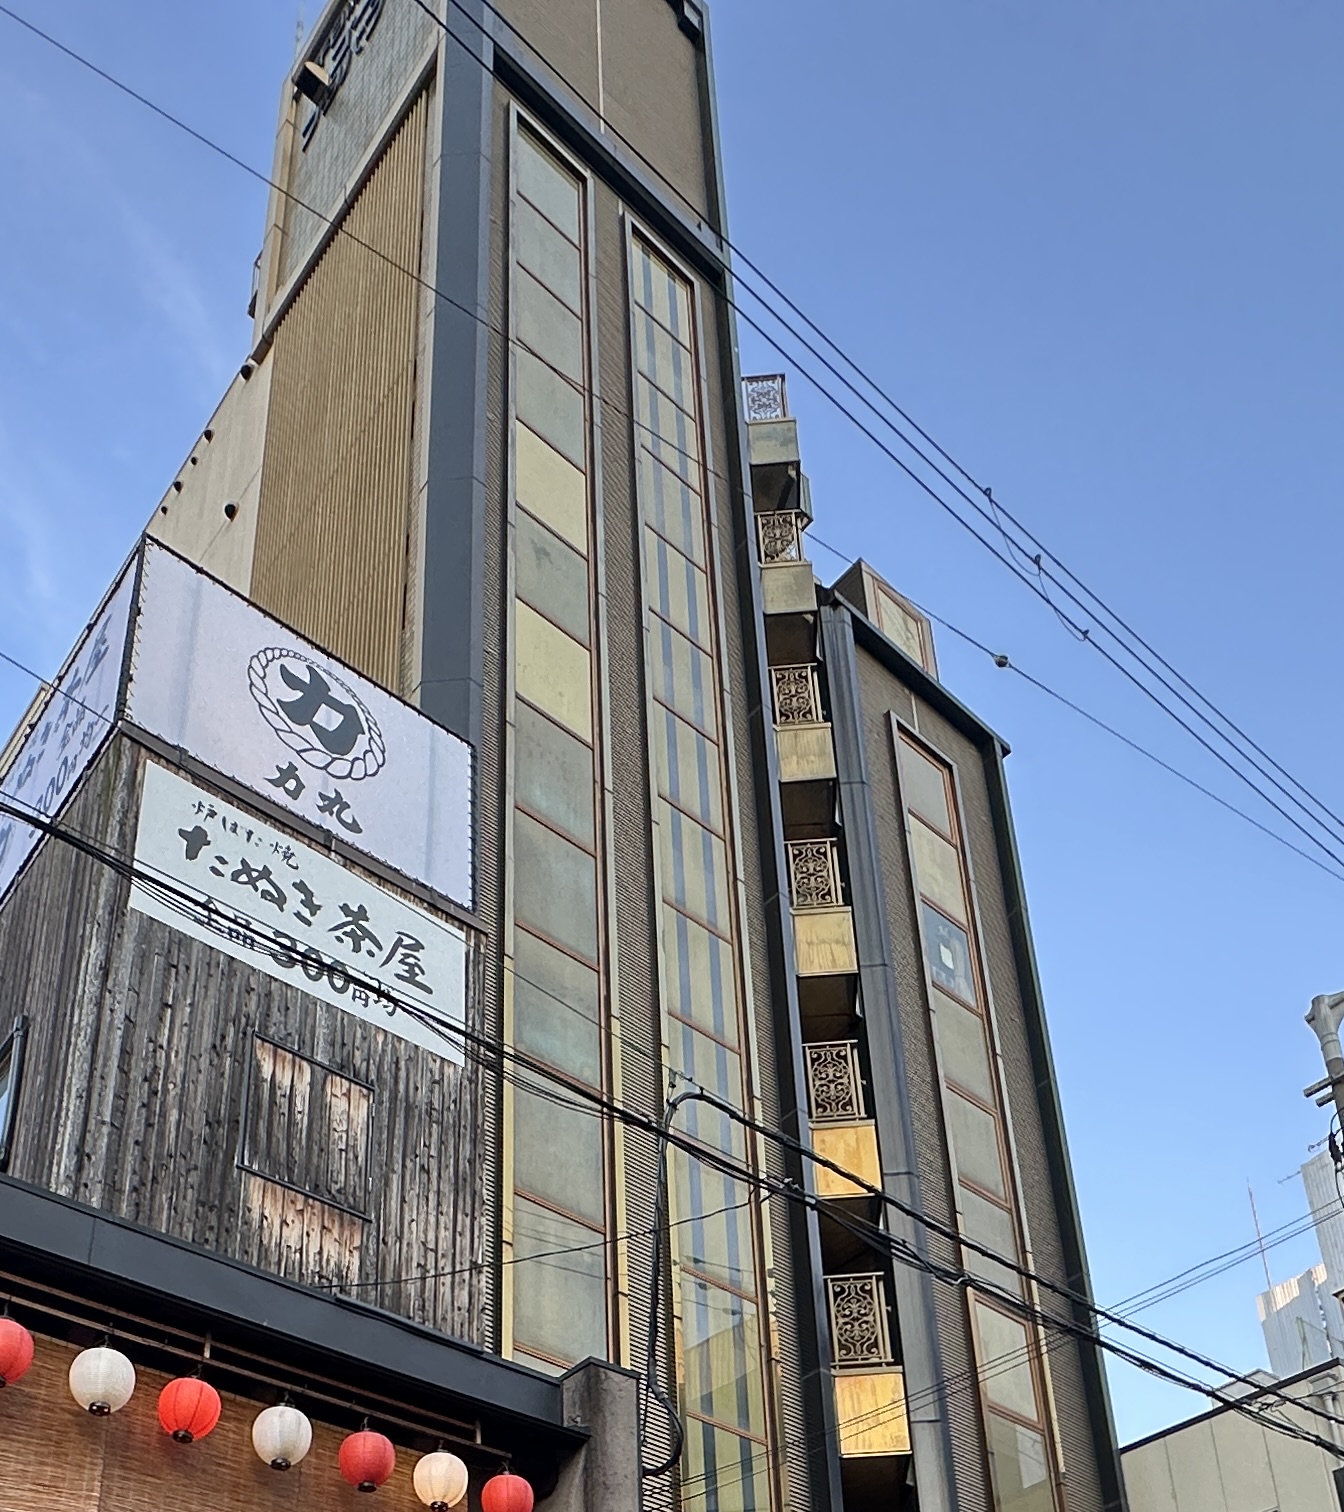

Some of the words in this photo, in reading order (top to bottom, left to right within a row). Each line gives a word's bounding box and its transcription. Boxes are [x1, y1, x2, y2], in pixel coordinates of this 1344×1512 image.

[264, 761, 364, 834] 力丸
[178, 825, 433, 995] たぬき茶屋
